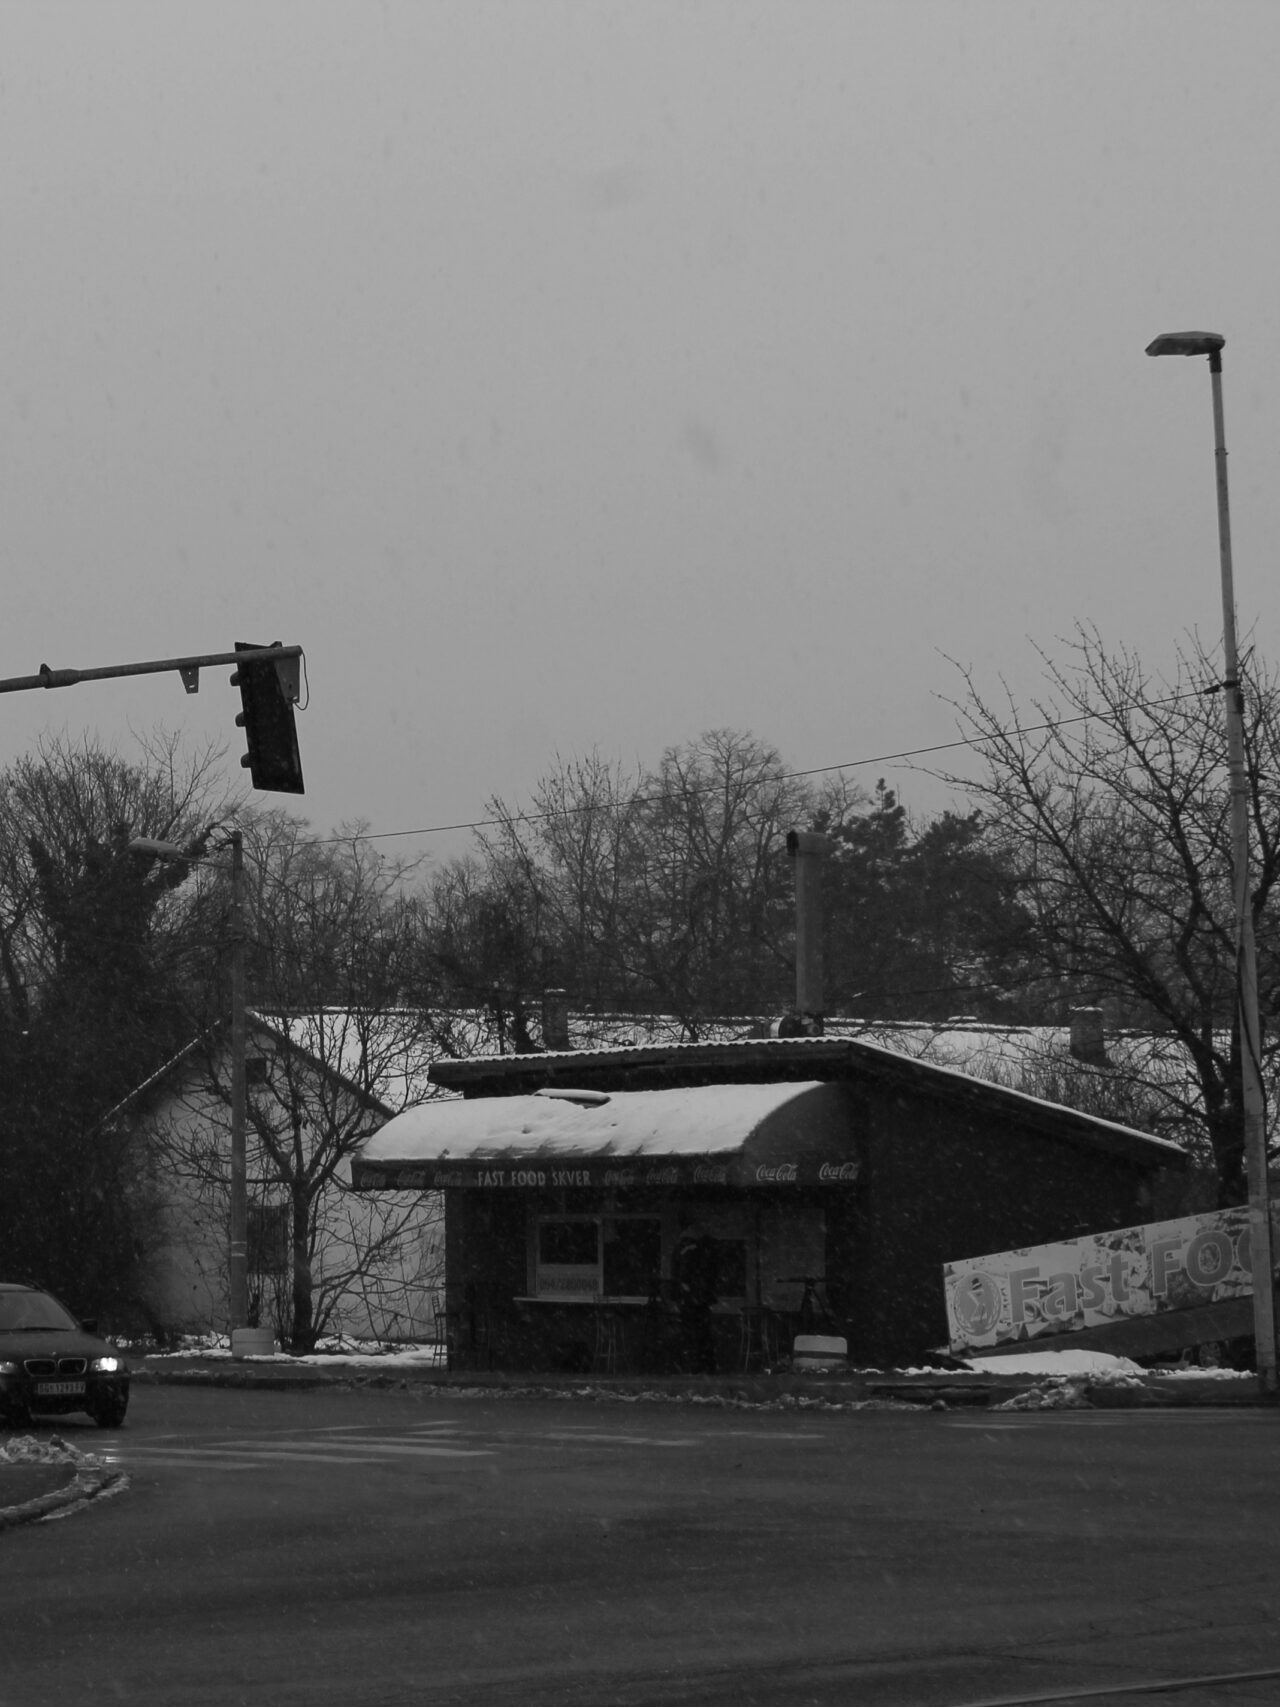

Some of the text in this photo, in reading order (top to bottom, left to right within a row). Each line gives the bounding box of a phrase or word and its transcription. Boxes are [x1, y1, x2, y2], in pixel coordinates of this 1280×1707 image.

[477, 1170, 505, 1187] FAST
[511, 1170, 546, 1187] FOOD
[552, 1170, 592, 1187] SKVER
[1009, 1252, 1130, 1325] Fast
